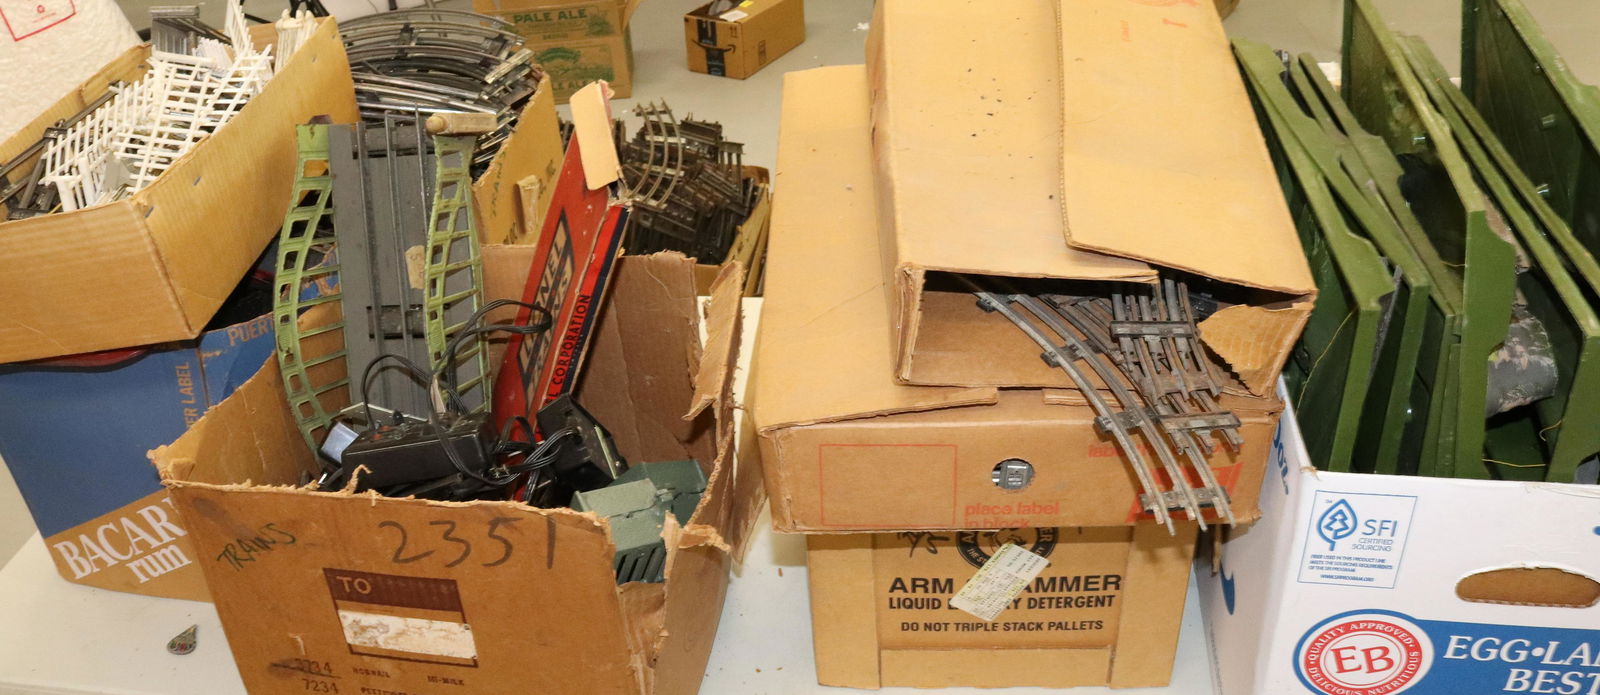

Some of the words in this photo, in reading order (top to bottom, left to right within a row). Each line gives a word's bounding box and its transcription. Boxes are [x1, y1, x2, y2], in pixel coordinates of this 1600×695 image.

[512, 12, 552, 24] PALE
[558, 9, 587, 20] ALE
[553, 295, 591, 386] CORPORATION
[175, 361, 197, 404] LABEL
[964, 502, 1012, 518] place
[1017, 502, 1060, 515] label
[983, 516, 1030, 528] block
[1362, 518, 1398, 537] SFI
[216, 522, 297, 572] TRAINS
[378, 515, 557, 570] 2351
[1351, 544, 1392, 552] SOURCING
[1358, 537, 1394, 545] CERTIFIED
[125, 544, 193, 584] rum
[336, 575, 372, 595] TO
[888, 577, 954, 594] ARM
[888, 597, 942, 611] LIQUID
[1027, 594, 1116, 610] DETERGENT
[901, 622, 919, 632] DO
[924, 622, 950, 632] NOT
[953, 622, 999, 632] TRIPLE
[1003, 621, 1043, 632] STACK
[1048, 620, 1104, 631] PALLETS
[1308, 625, 1346, 660] QUALITY
[1350, 622, 1414, 646] APPROVED
[1330, 645, 1395, 674] EB
[1367, 651, 1420, 695] NUTRITIOUS
[302, 678, 339, 695] 7234
